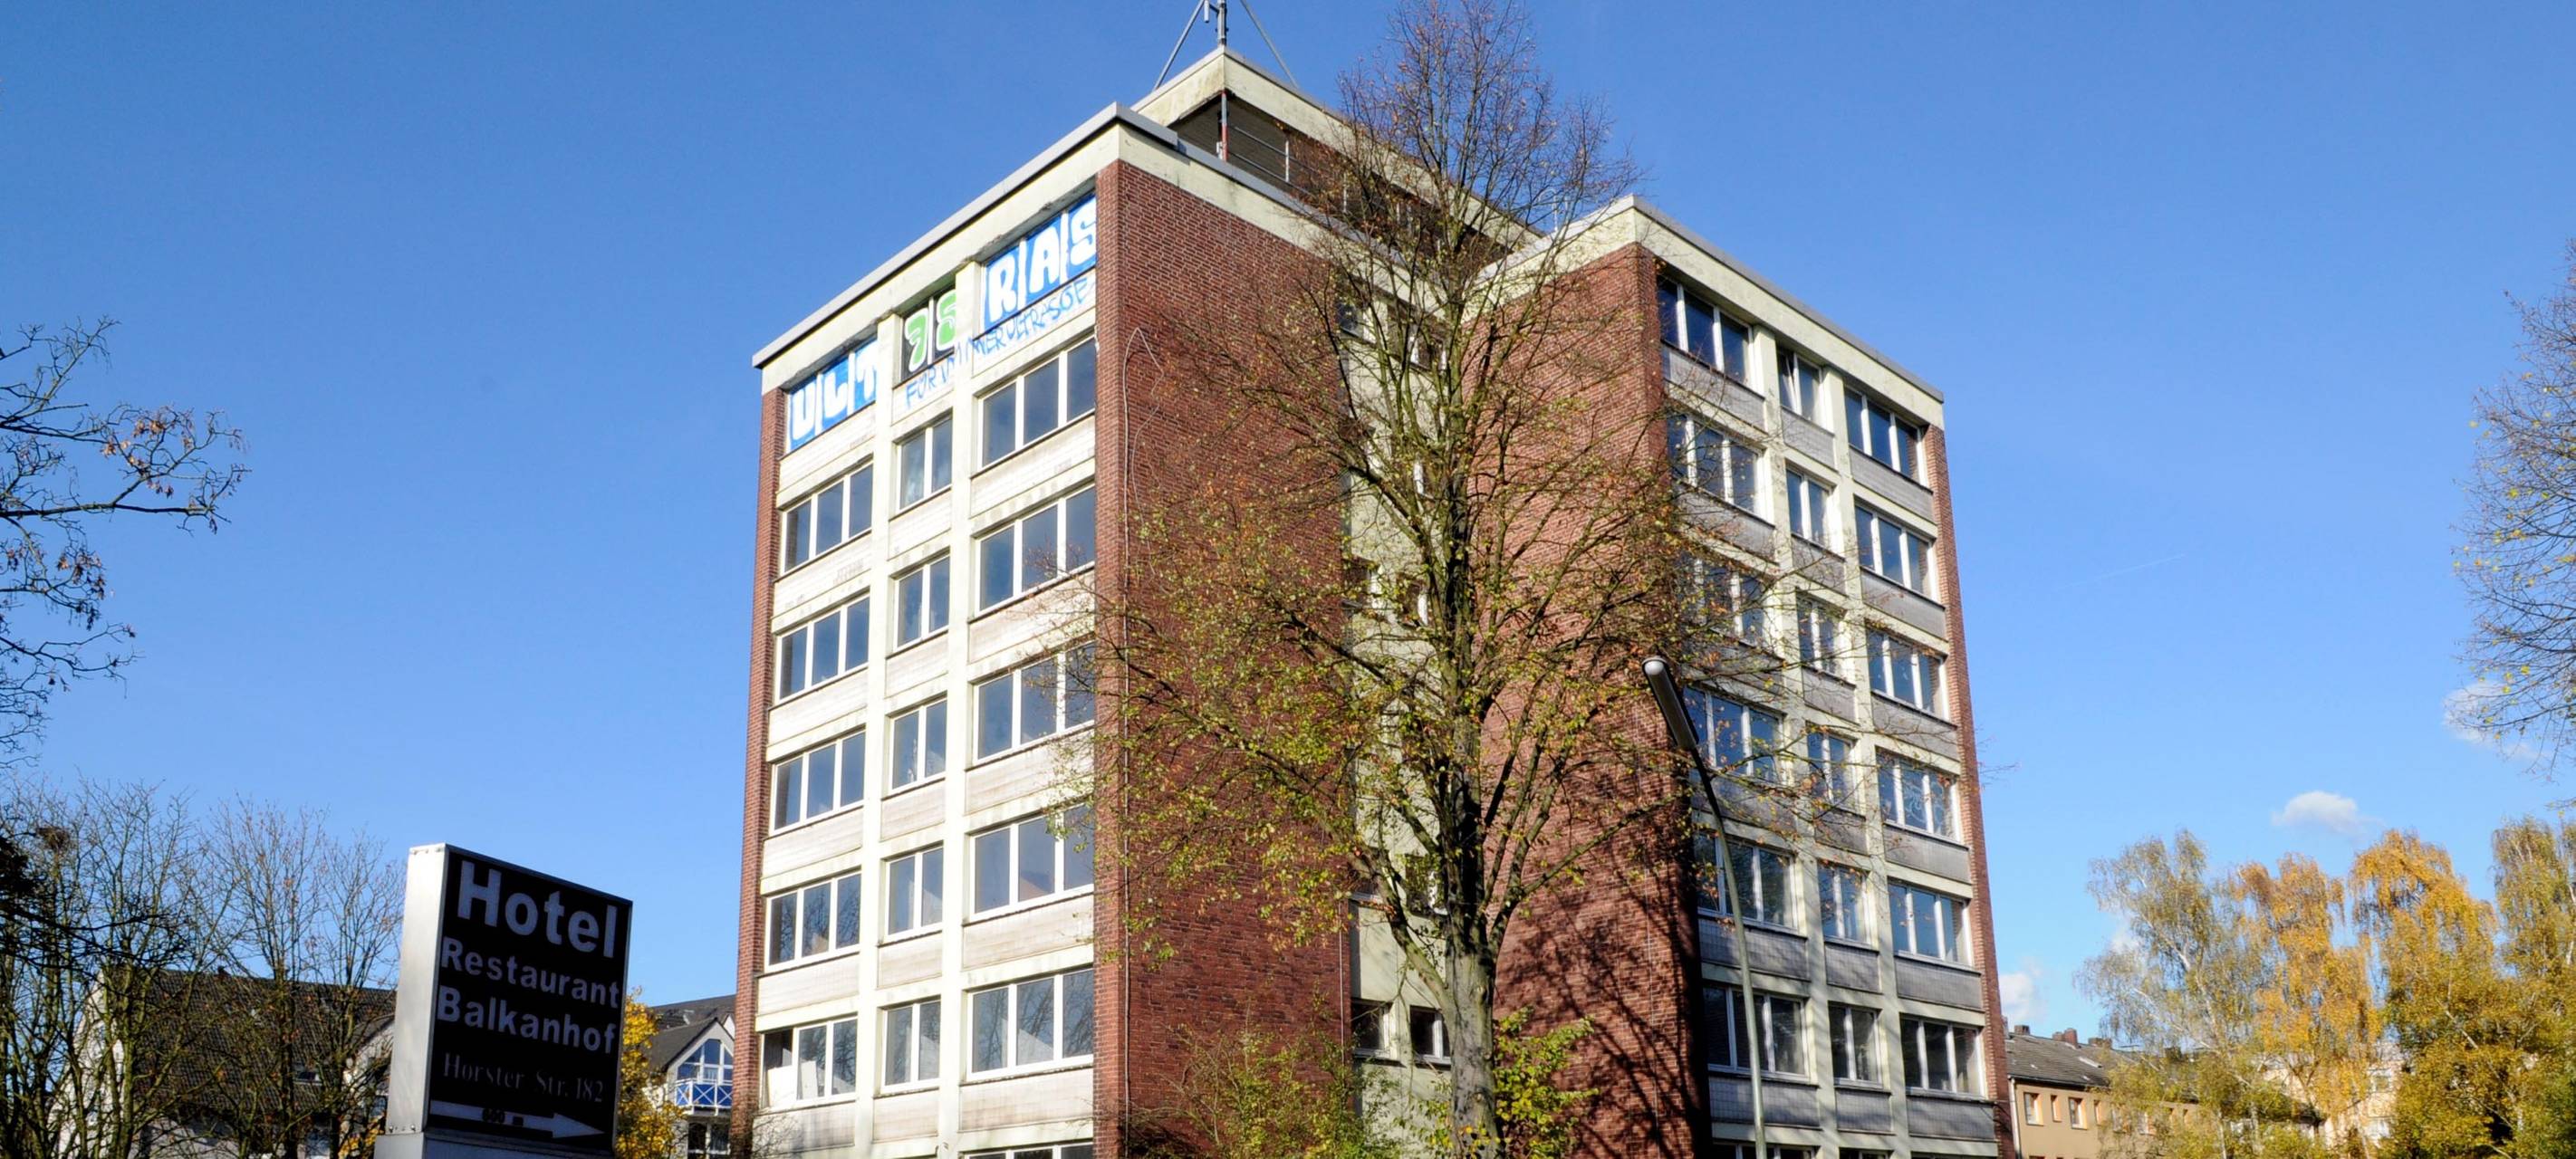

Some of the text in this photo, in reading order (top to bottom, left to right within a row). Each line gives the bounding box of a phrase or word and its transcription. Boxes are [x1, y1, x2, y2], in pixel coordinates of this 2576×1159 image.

[457, 860, 618, 958] Hotel
[441, 935, 619, 1009] Restaurant
[437, 984, 617, 1054] Balkanhof
[443, 1052, 604, 1103] Horster Str. 182
